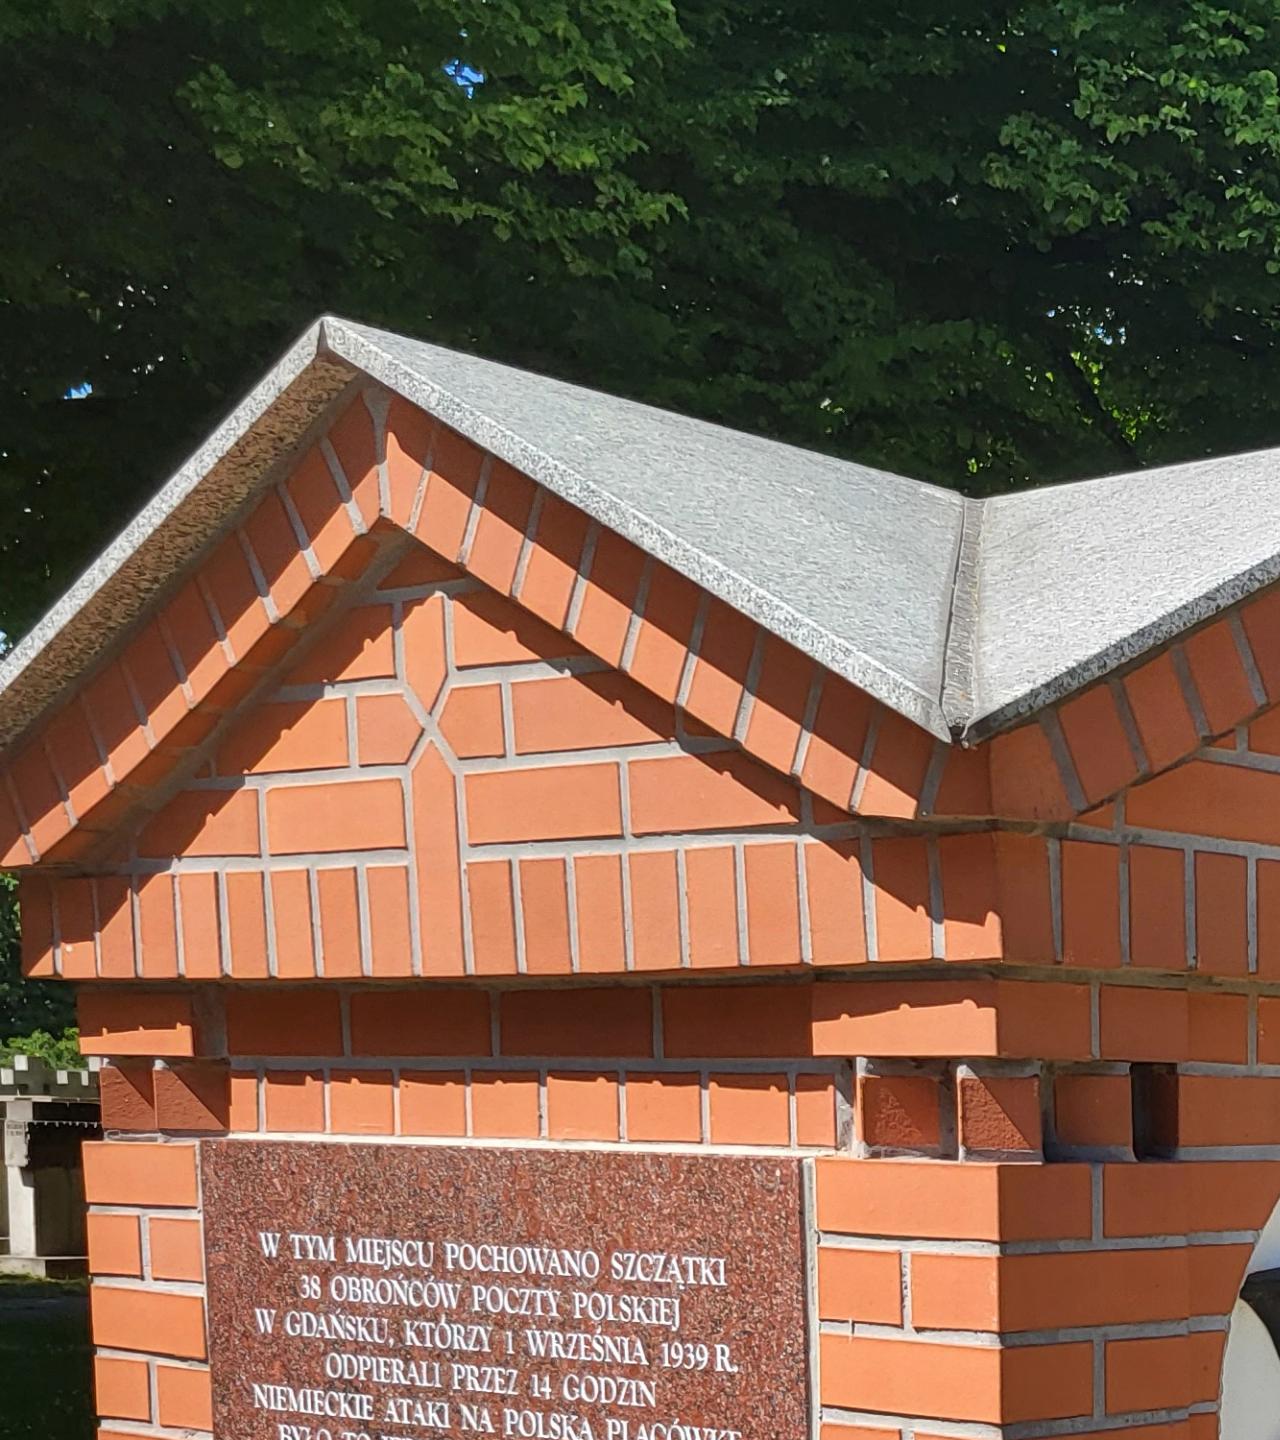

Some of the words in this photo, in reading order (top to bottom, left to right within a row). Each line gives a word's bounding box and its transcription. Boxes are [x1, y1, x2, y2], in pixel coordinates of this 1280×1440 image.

[260, 1232, 280, 1258] W
[290, 1234, 336, 1261] TYM
[346, 1237, 434, 1270] MIEJSCU
[444, 1242, 600, 1279] POCHOWANO
[611, 1252, 727, 1290] SZCZĄTKI
[300, 1275, 321, 1299] 38
[330, 1274, 460, 1309] OBROŃCÓW
[473, 1284, 561, 1316] POCZTY
[573, 1292, 680, 1332] POLSKIEJ
[255, 1308, 276, 1333] W
[286, 1308, 394, 1347] GDAŃSKU,
[404, 1315, 492, 1353] KTÓRZY
[506, 1331, 515, 1354] 1
[526, 1326, 649, 1366] WRZEŚNIA
[662, 1341, 708, 1371] 1939
[714, 1344, 738, 1373] R.
[251, 1383, 374, 1420] NIEMIECKIE
[384, 1398, 450, 1428] ATAKI
[461, 1404, 495, 1433] NA
[326, 1353, 442, 1388] ODPIERALI
[452, 1363, 518, 1395] PRZEZ
[532, 1374, 552, 1400] 14
[563, 1375, 656, 1407] GODZIN
